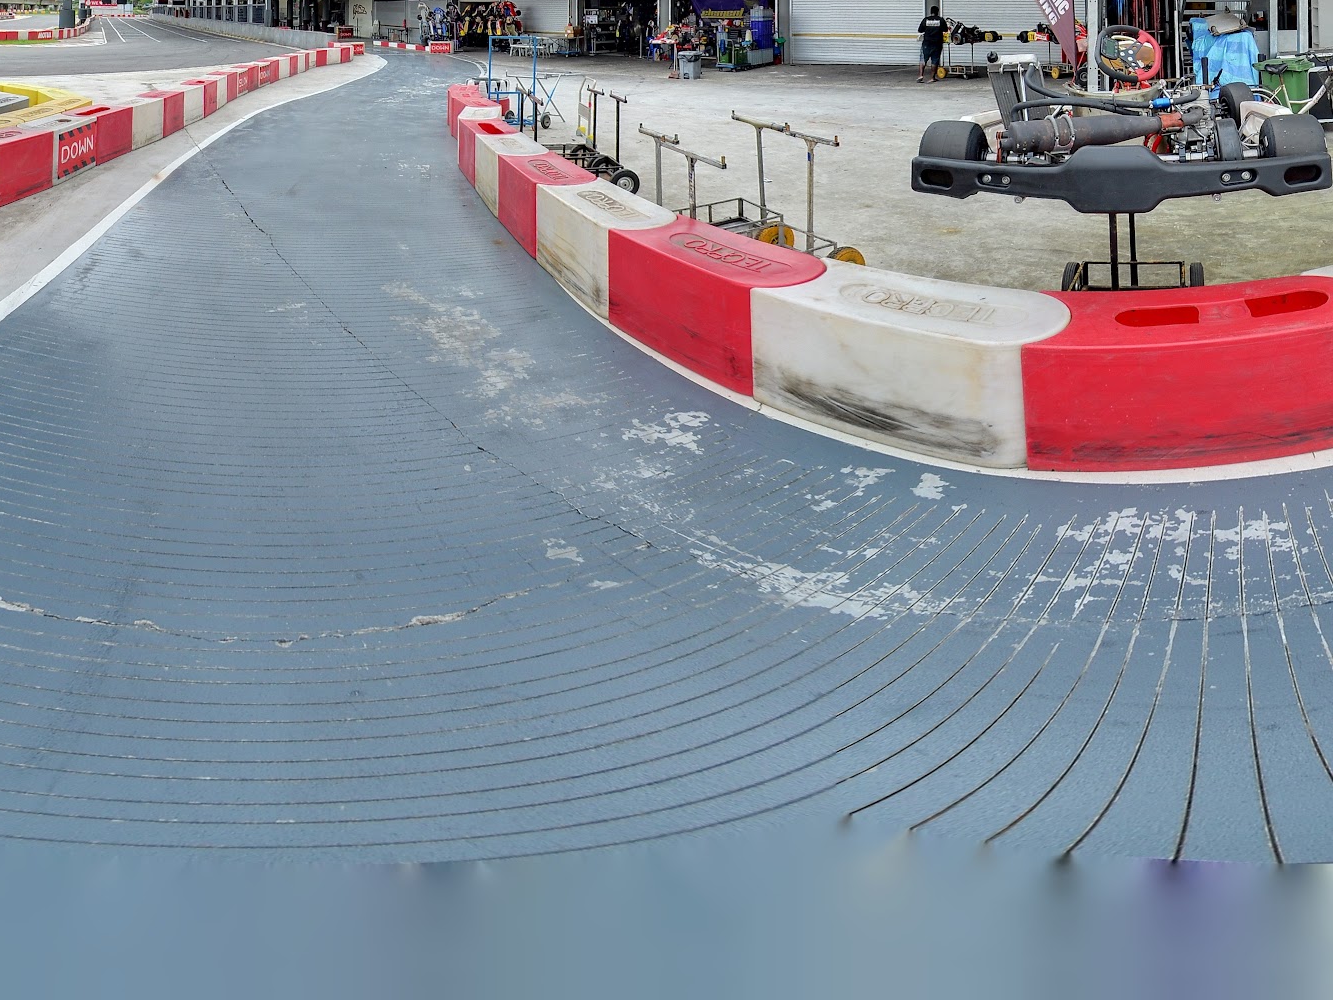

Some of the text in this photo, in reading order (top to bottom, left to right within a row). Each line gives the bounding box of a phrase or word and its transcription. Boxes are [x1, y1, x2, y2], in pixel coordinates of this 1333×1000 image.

[60, 134, 94, 164] DOWN
[684, 240, 772, 273] TECPRO
[862, 287, 996, 323] TECPRO
